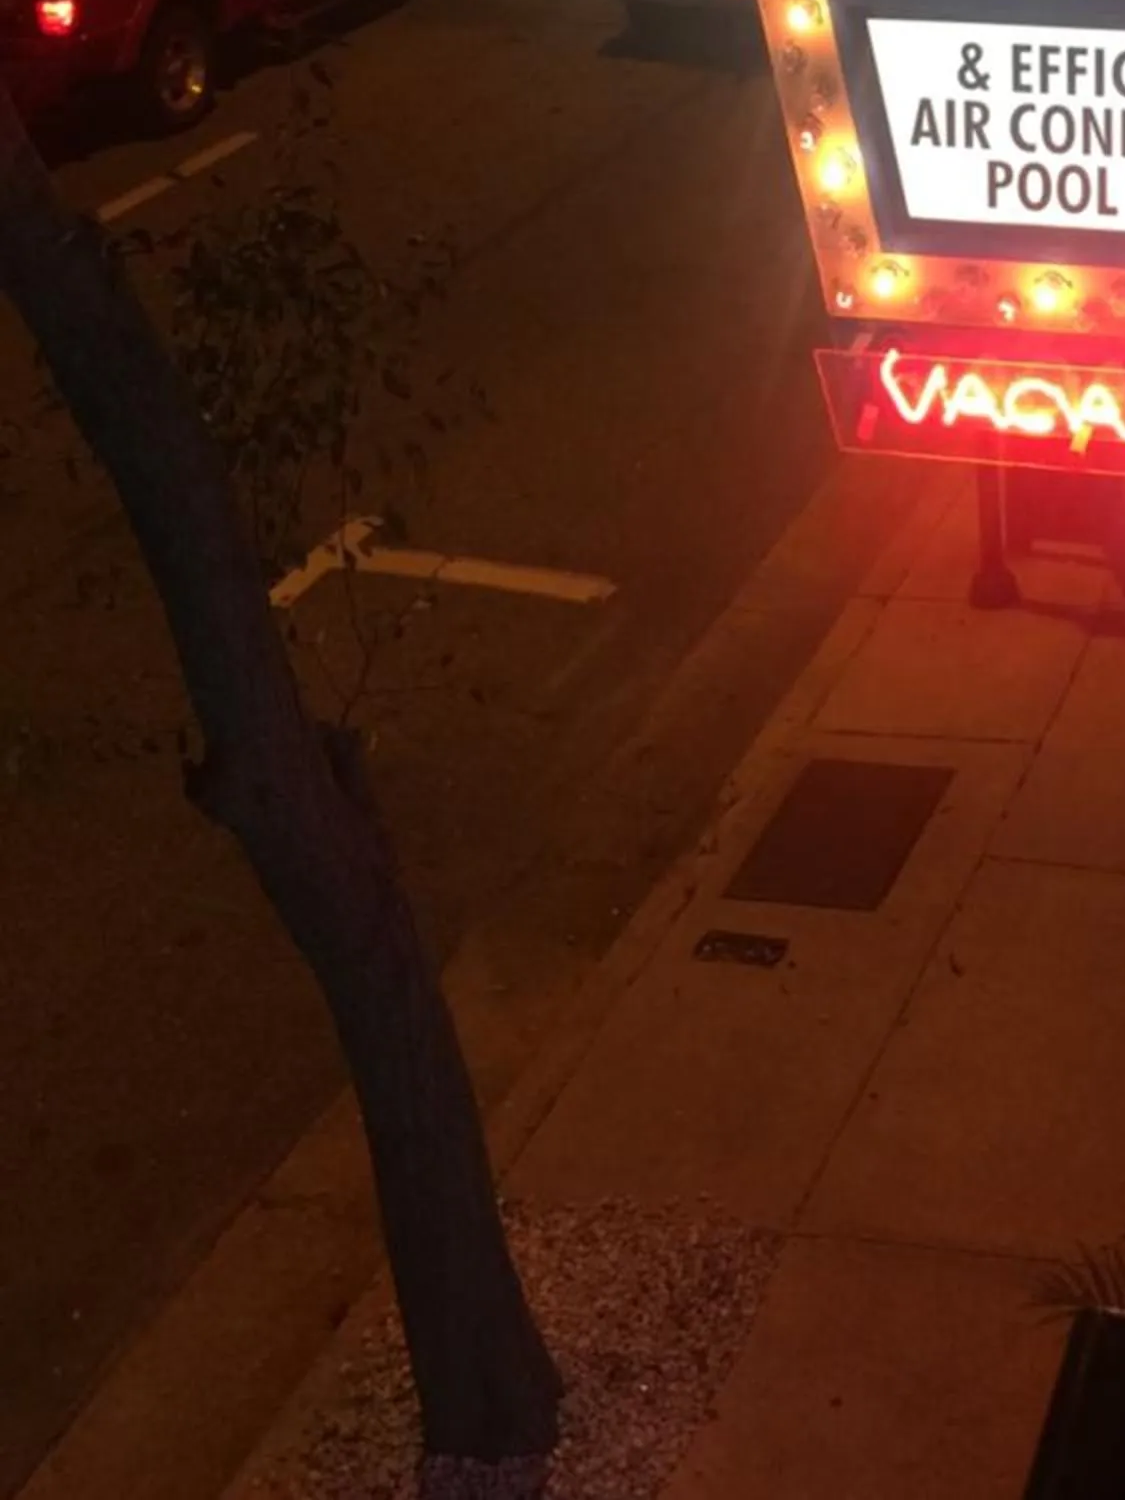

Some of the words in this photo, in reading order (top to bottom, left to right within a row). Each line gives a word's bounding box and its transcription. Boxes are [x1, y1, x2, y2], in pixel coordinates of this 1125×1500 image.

[957, 41, 992, 92] &
[911, 97, 992, 150] AIR
[987, 160, 1119, 217] POOL
